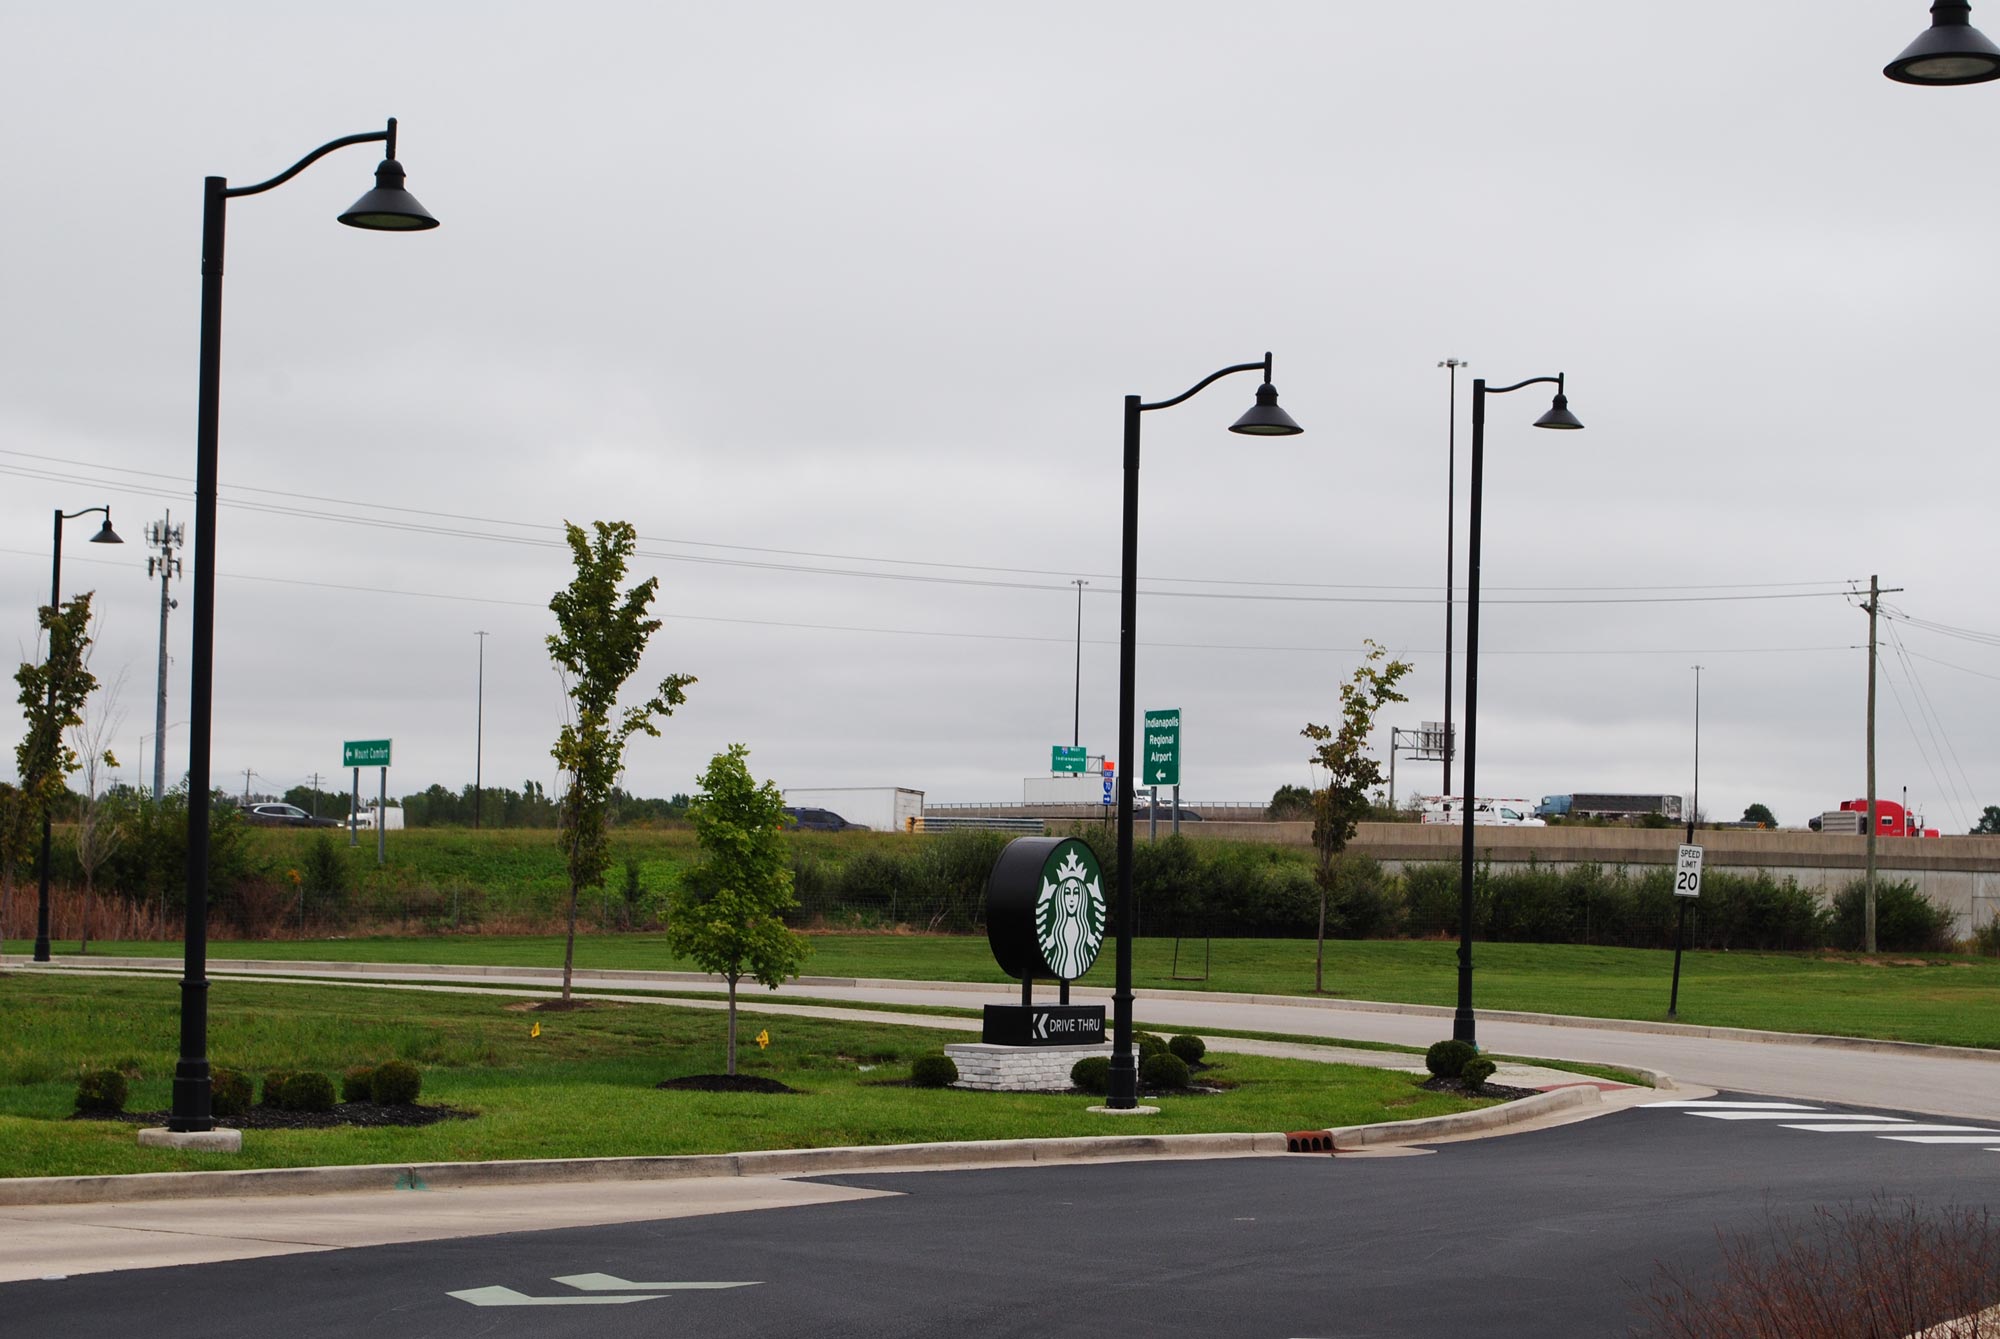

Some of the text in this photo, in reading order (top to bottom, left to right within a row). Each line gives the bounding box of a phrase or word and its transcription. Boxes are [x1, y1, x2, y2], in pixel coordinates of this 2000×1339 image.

[1145, 717, 1179, 729] Indianapolis
[1149, 734, 1174, 748] Regional
[354, 747, 388, 759] Mount Comfort
[1150, 752, 1172, 763] Airport
[1680, 849, 1701, 858] SPEED
[1681, 861, 1697, 869] LIMIT
[1677, 871, 1698, 891] 20
[1049, 1018, 1100, 1032] DRIVE THRU
